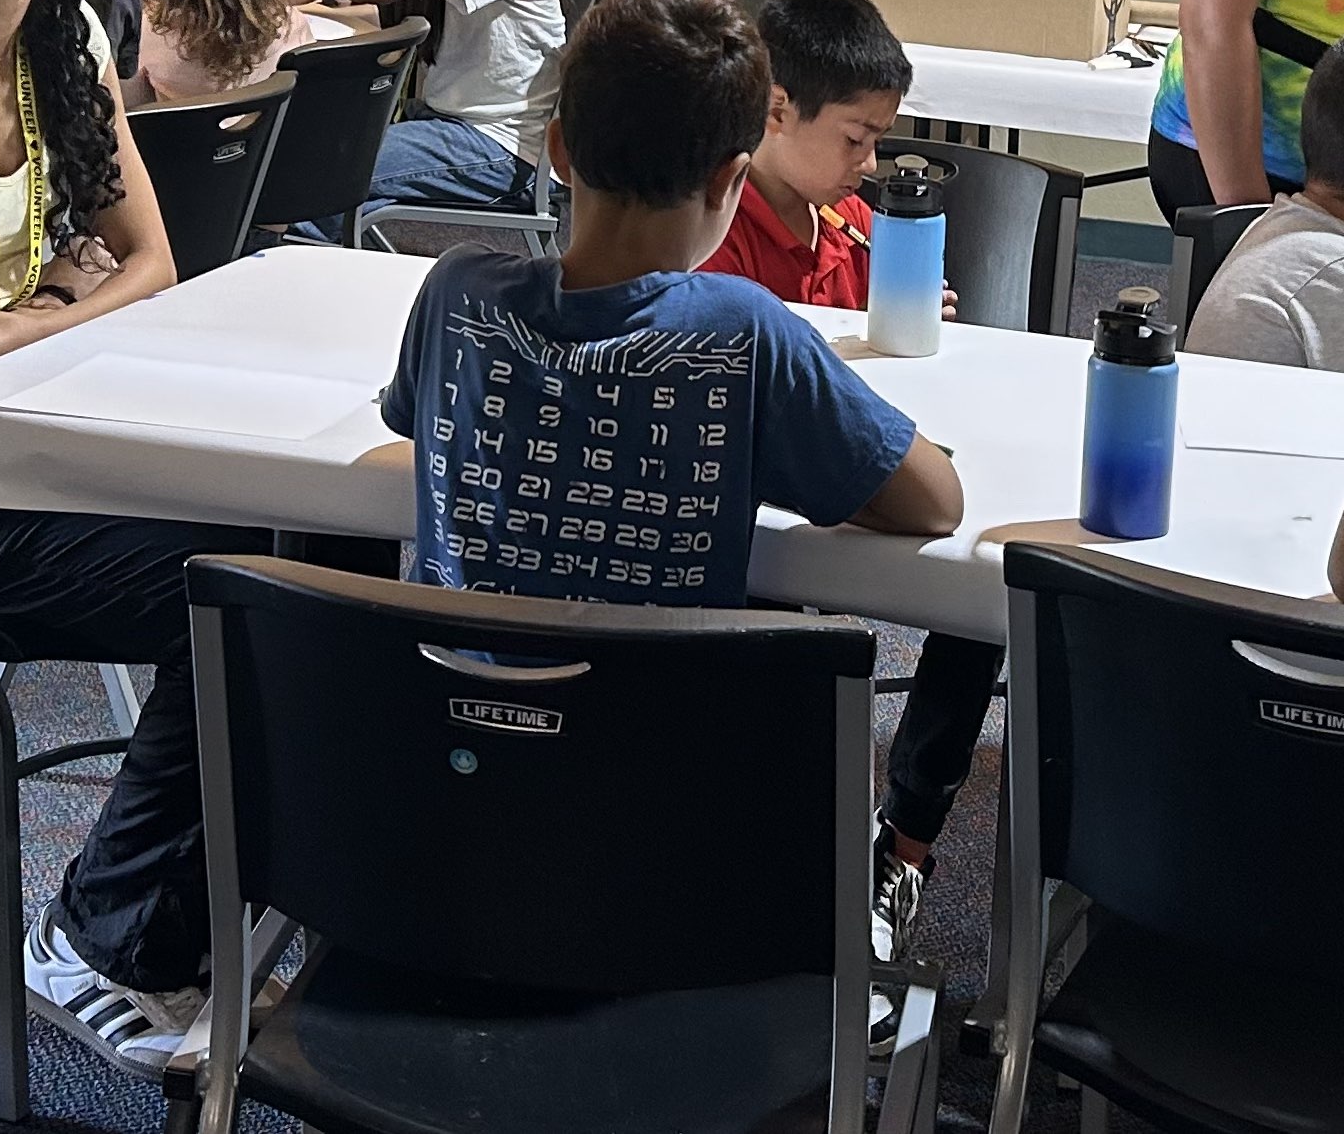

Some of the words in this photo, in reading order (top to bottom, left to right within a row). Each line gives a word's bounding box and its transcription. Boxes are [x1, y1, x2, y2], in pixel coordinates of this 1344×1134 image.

[31, 156, 43, 241] VOLUNTEER
[456, 348, 463, 370] 1
[489, 360, 513, 384] 2
[542, 375, 563, 398] 3
[597, 384, 621, 407] 4
[652, 386, 675, 409] 5
[708, 387, 728, 409] 6
[445, 382, 458, 406] 7
[483, 395, 506, 418] 8
[538, 405, 561, 427] 9
[588, 417, 619, 438] 10
[650, 423, 669, 446] 11
[698, 423, 727, 447] 12
[434, 416, 456, 442] 13
[474, 428, 504, 455] 14
[527, 438, 558, 464] 15
[583, 446, 614, 471] 16
[639, 456, 667, 480] 17
[692, 461, 721, 483] 18
[429, 451, 447, 478] 19
[460, 462, 502, 490] 20
[518, 473, 551, 500] 21
[566, 481, 614, 508] 22
[621, 488, 668, 516] 23
[676, 495, 720, 519] 24
[453, 497, 497, 525] 26
[506, 508, 549, 536] 27
[559, 516, 607, 543] 28
[614, 523, 661, 551] 29
[669, 531, 713, 554] 30
[446, 533, 489, 562] 32
[496, 544, 542, 571] 33
[550, 553, 599, 579] 34
[606, 559, 653, 586] 35
[661, 566, 706, 588] 36
[462, 703, 549, 727] LIFETIME
